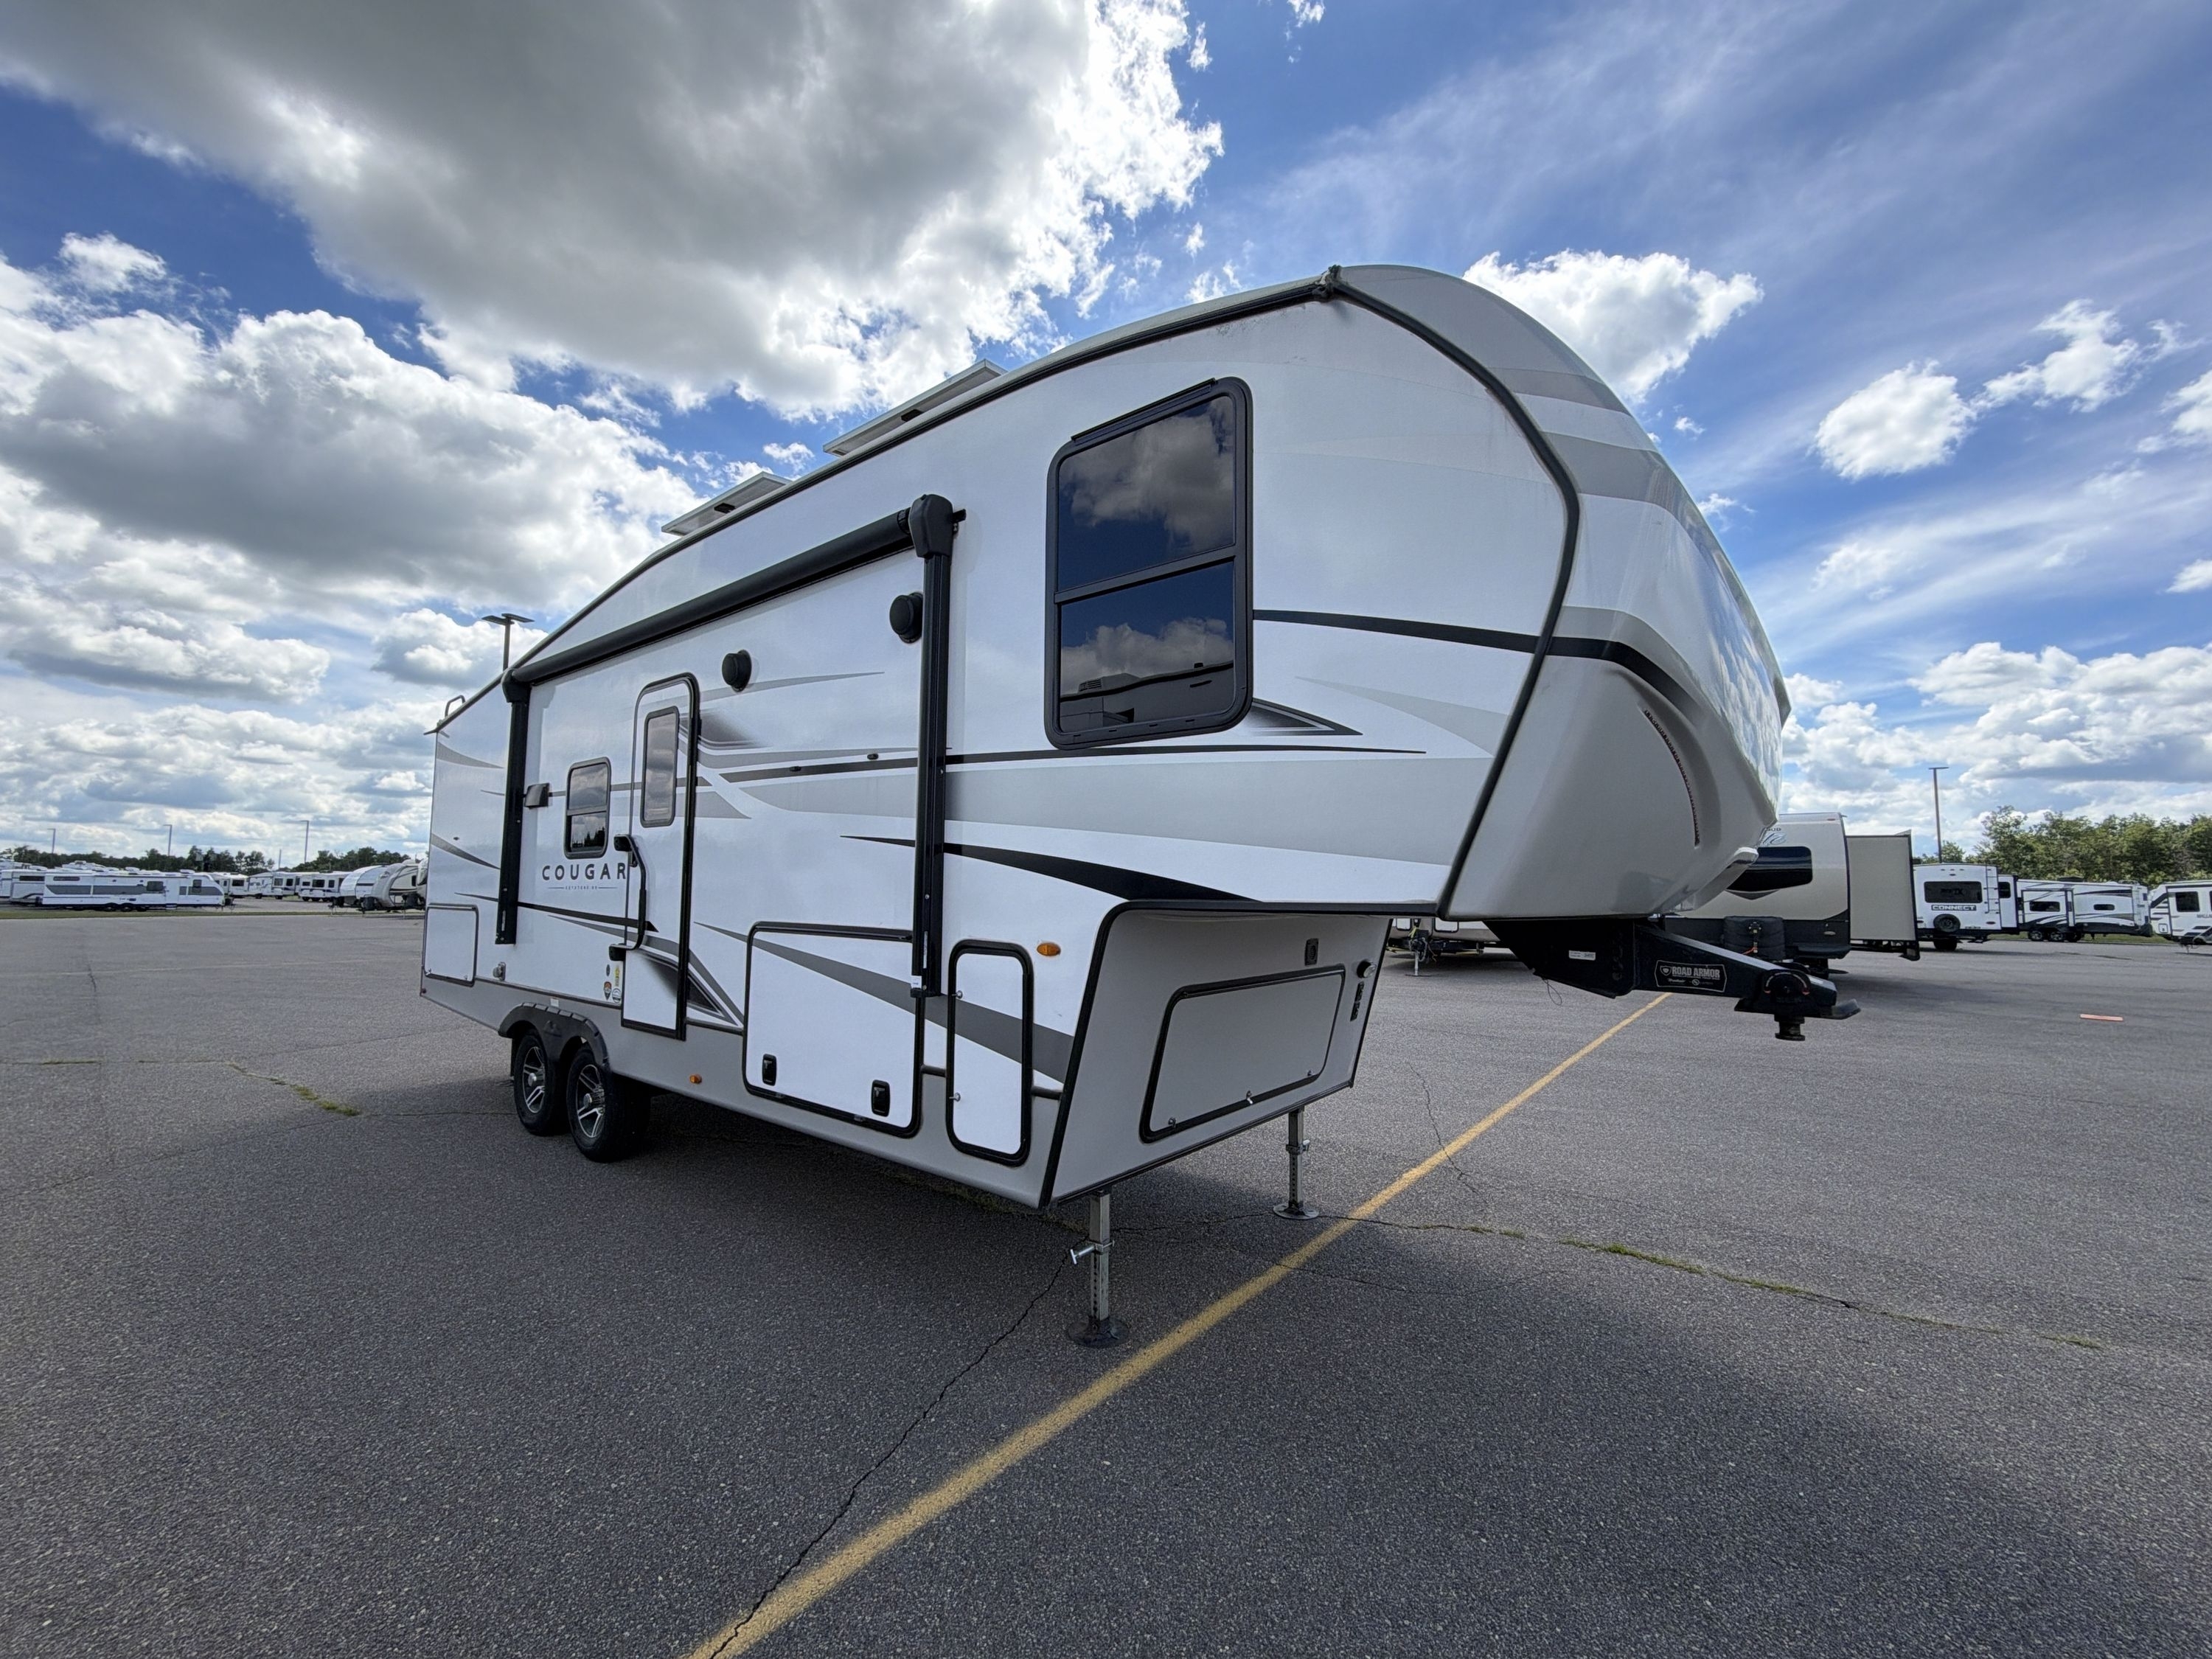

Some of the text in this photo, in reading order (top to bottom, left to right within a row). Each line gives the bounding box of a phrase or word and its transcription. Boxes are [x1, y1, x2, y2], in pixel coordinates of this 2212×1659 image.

[542, 862, 626, 880] COUGAR
[1672, 966, 1692, 976] ROAD
[1693, 967, 1720, 978] ARMOR
